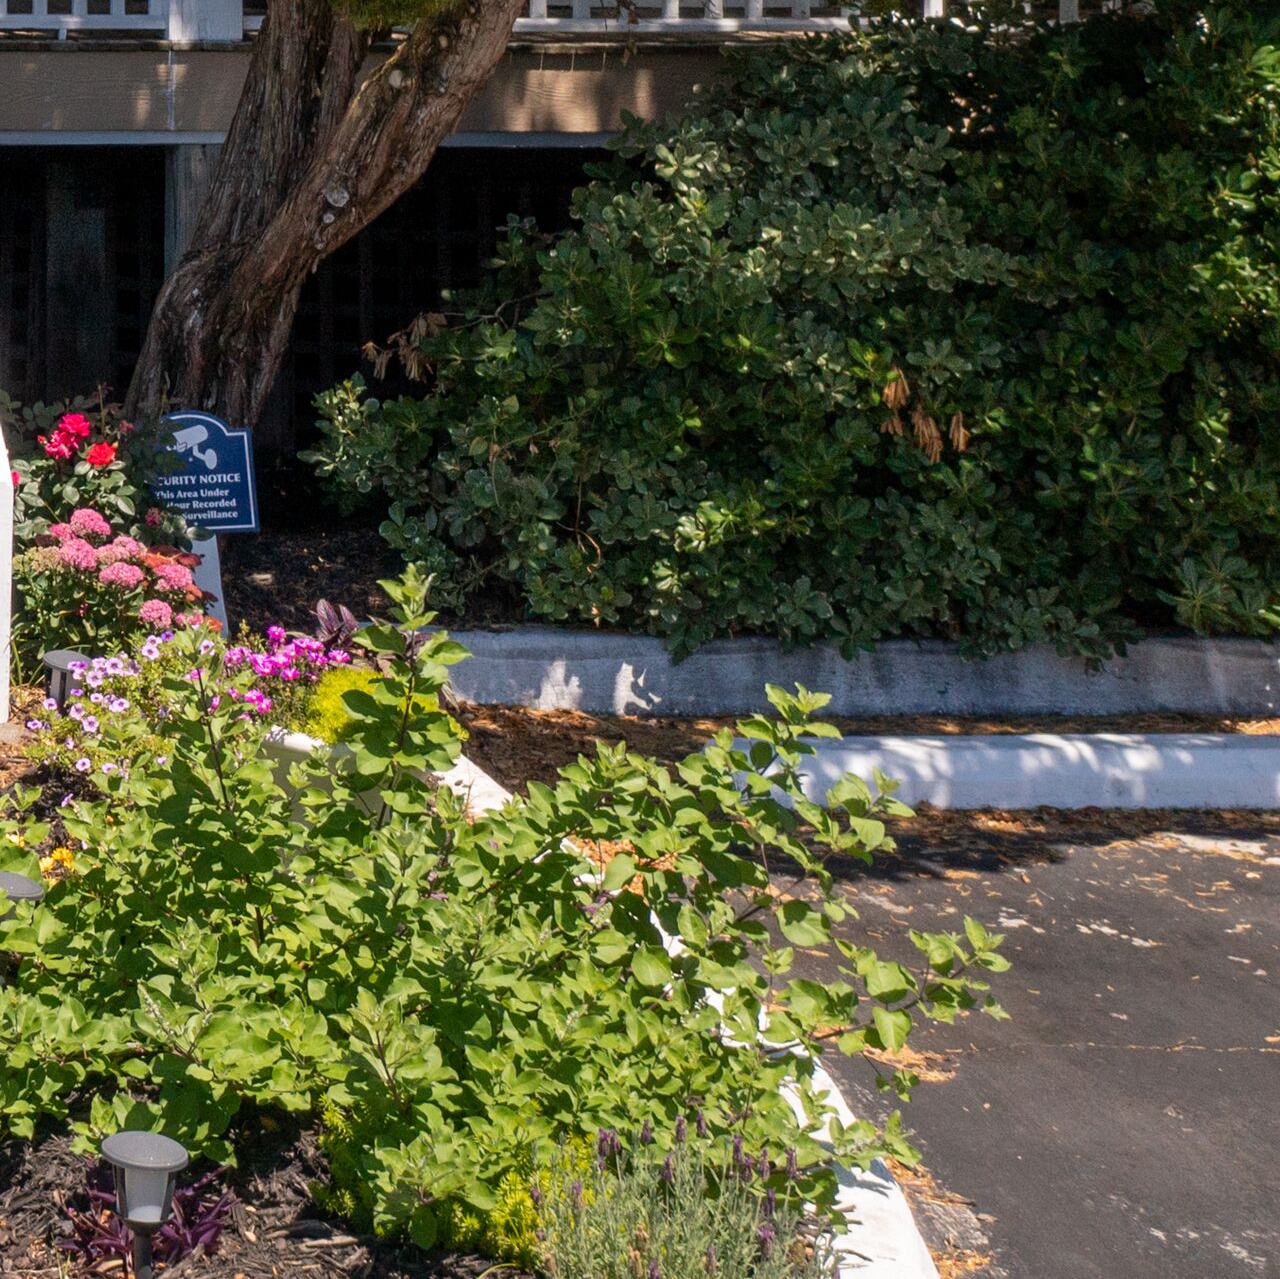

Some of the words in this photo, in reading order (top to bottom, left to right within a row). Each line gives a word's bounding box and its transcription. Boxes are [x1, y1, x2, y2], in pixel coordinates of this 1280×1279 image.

[158, 475, 196, 486] CURITY
[199, 473, 241, 484] NOTICE
[156, 490, 175, 500] This
[176, 490, 198, 498] Area
[200, 488, 230, 497] Under
[192, 498, 237, 509] Recorded
[183, 510, 239, 520] Surveillance
